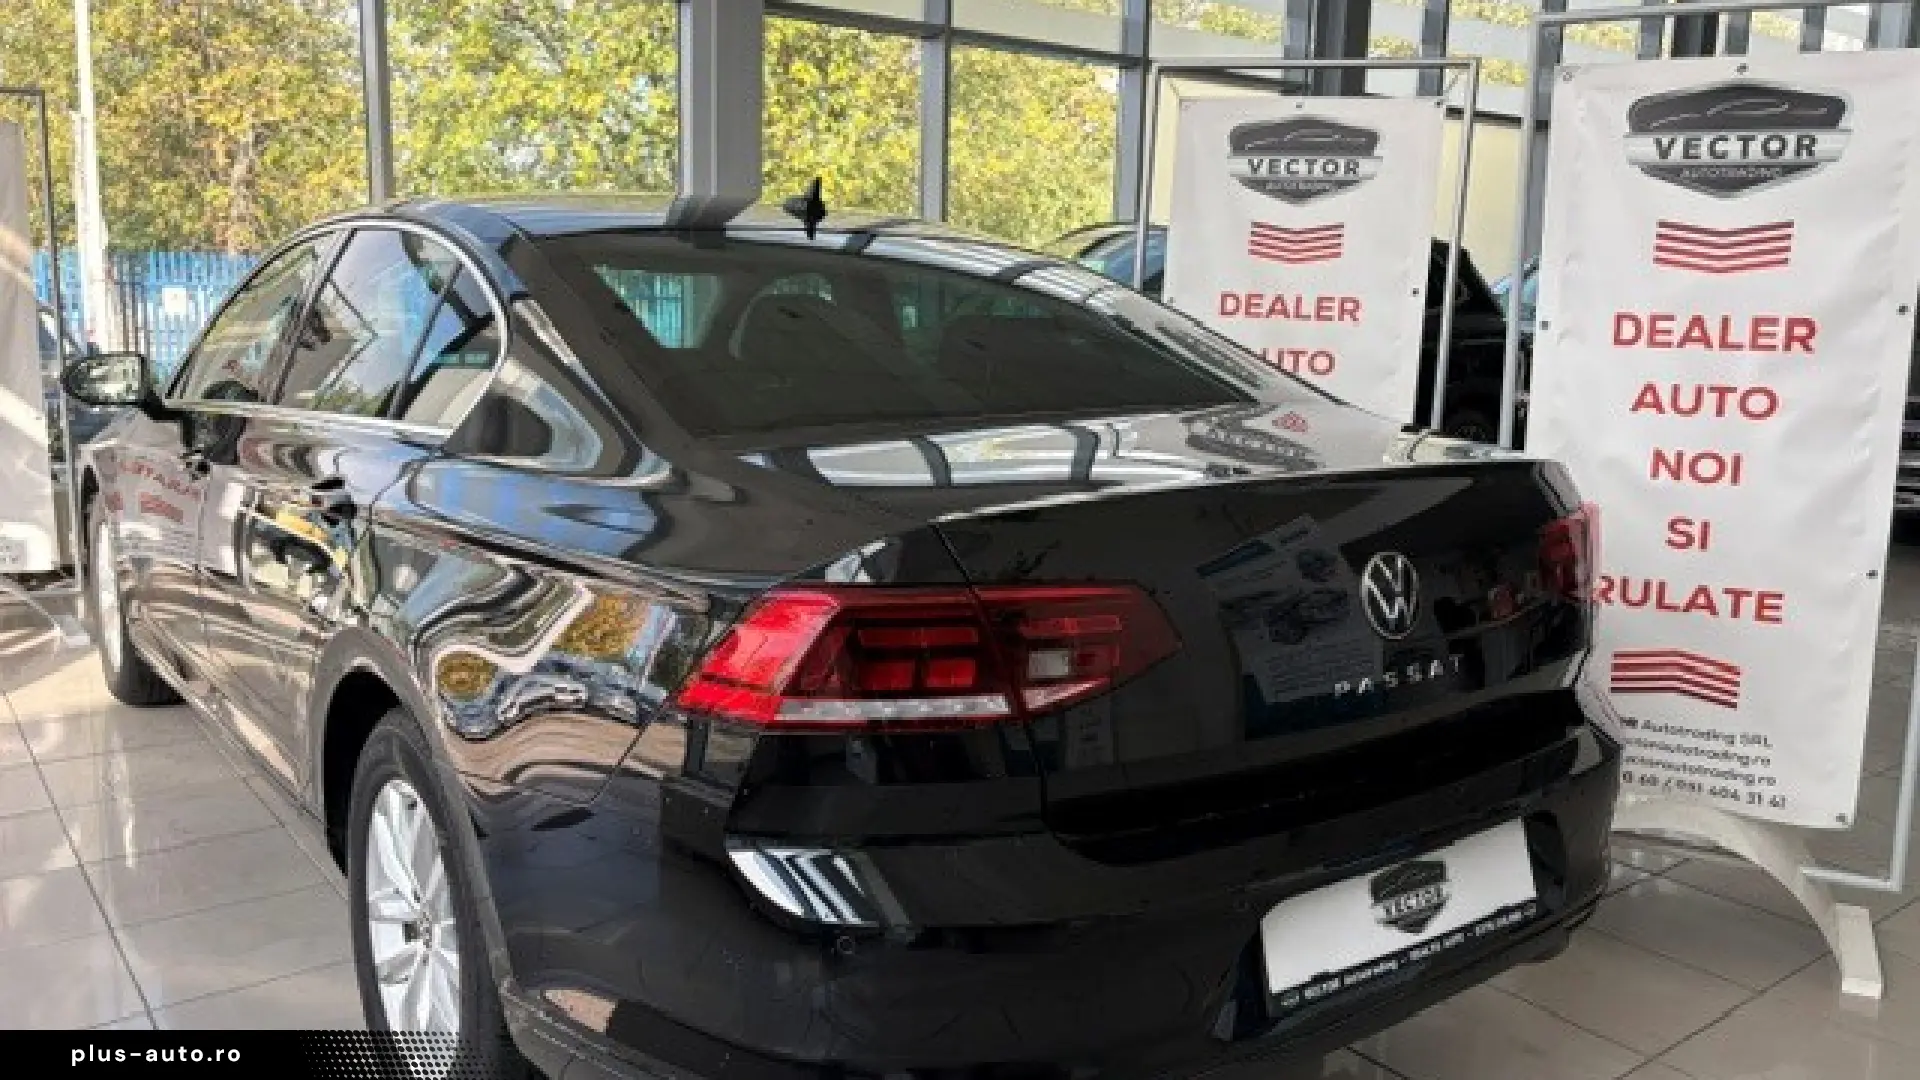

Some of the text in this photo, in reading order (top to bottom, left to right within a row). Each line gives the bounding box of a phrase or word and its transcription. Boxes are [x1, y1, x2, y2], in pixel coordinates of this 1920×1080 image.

[1653, 133, 1818, 160] VECTOR
[1248, 158, 1360, 176] VECTOR
[1218, 291, 1362, 325] DEALER
[1613, 312, 1818, 353] DEALER
[1261, 347, 1336, 375] UTO
[1629, 381, 1780, 420] AUTO
[1650, 448, 1743, 486] NOI
[1665, 516, 1711, 552] SI
[1595, 575, 1785, 625] RULATE
[1335, 653, 1463, 697] PASSAT
